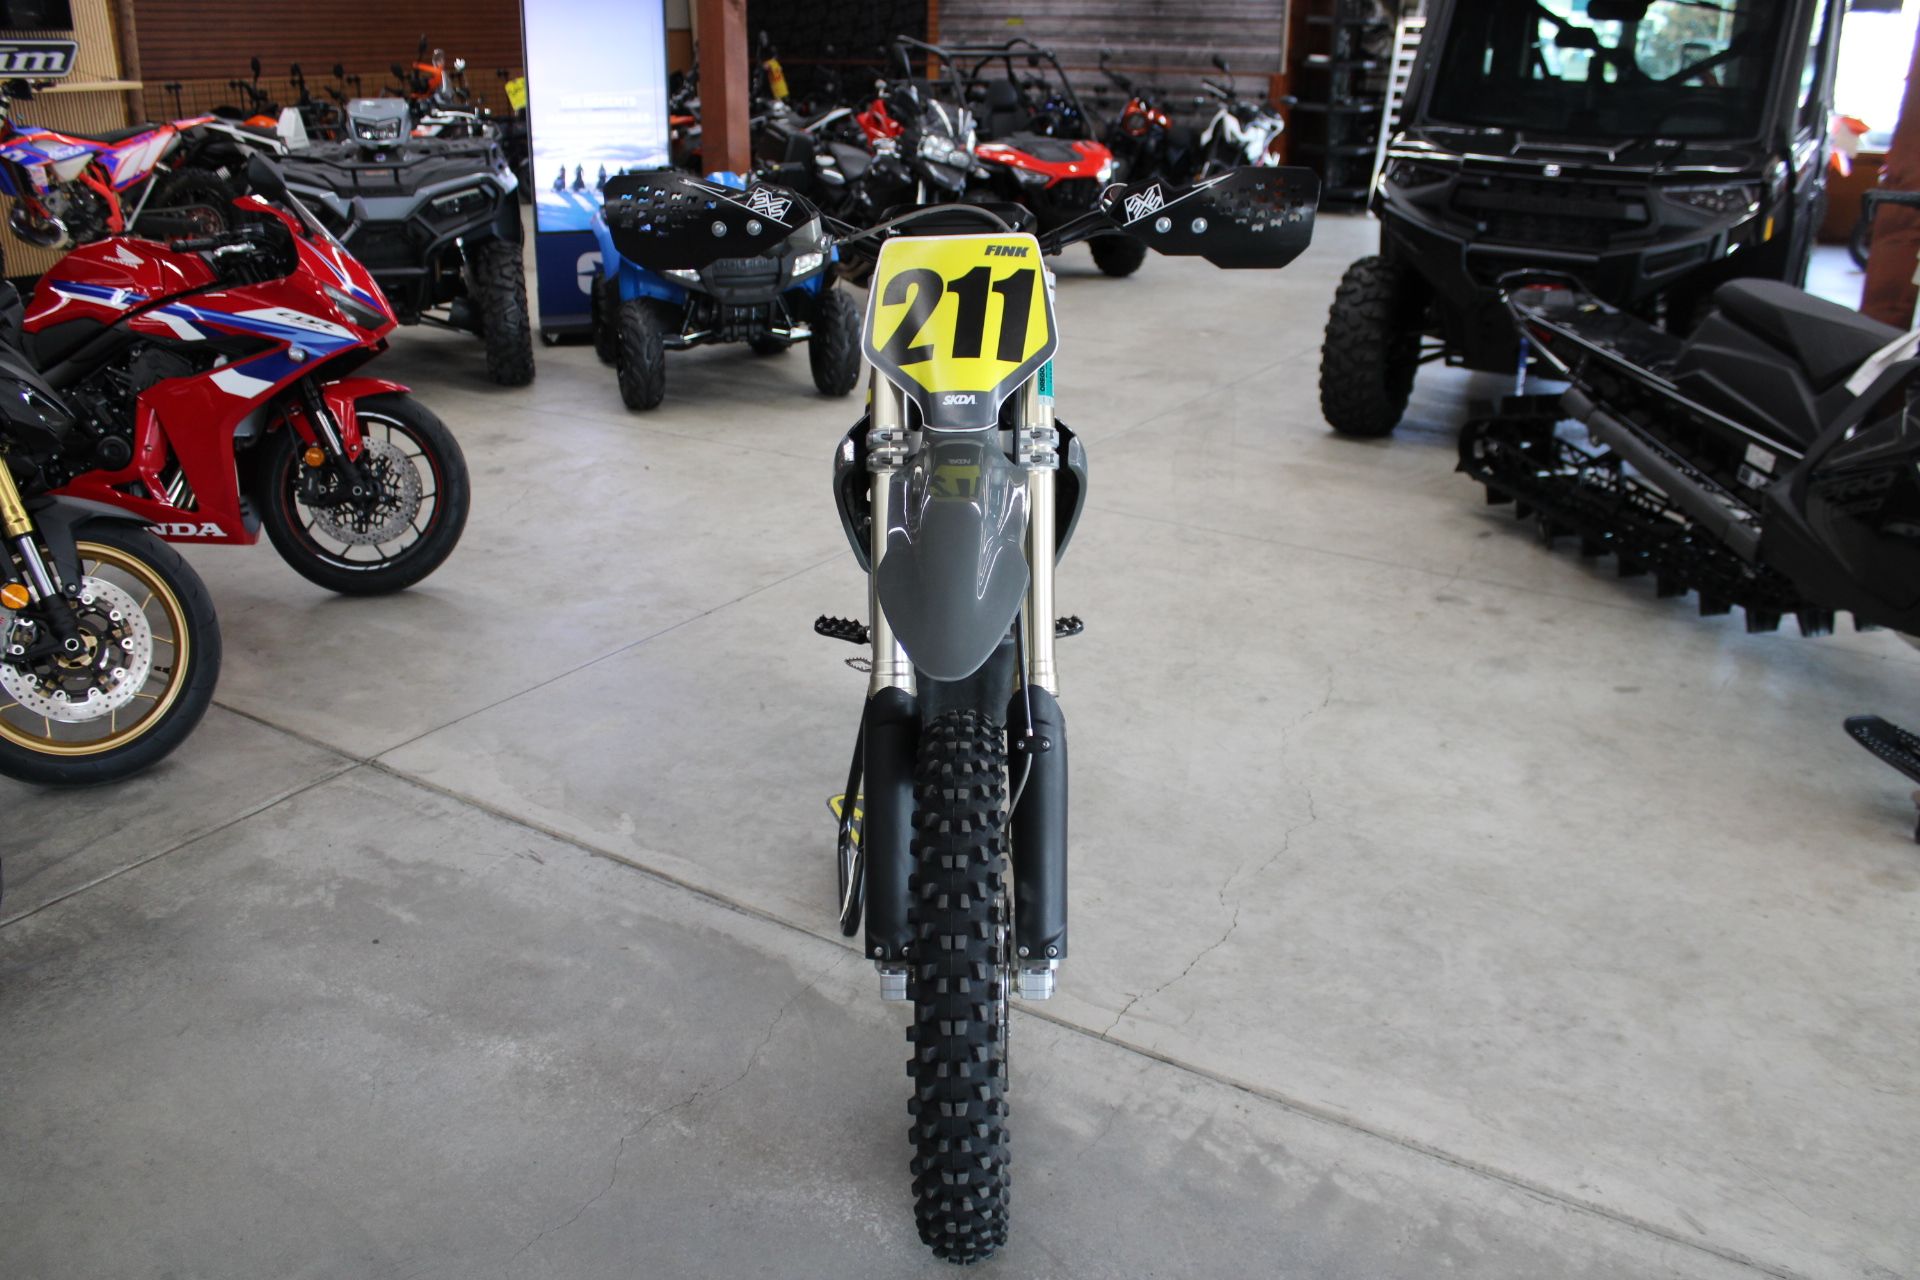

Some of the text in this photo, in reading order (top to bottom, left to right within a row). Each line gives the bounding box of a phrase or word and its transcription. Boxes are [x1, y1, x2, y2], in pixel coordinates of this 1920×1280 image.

[984, 245, 1030, 258] FINK
[880, 266, 1036, 366] 211
[942, 394, 977, 406] SKDA
[143, 522, 228, 537] NDA
